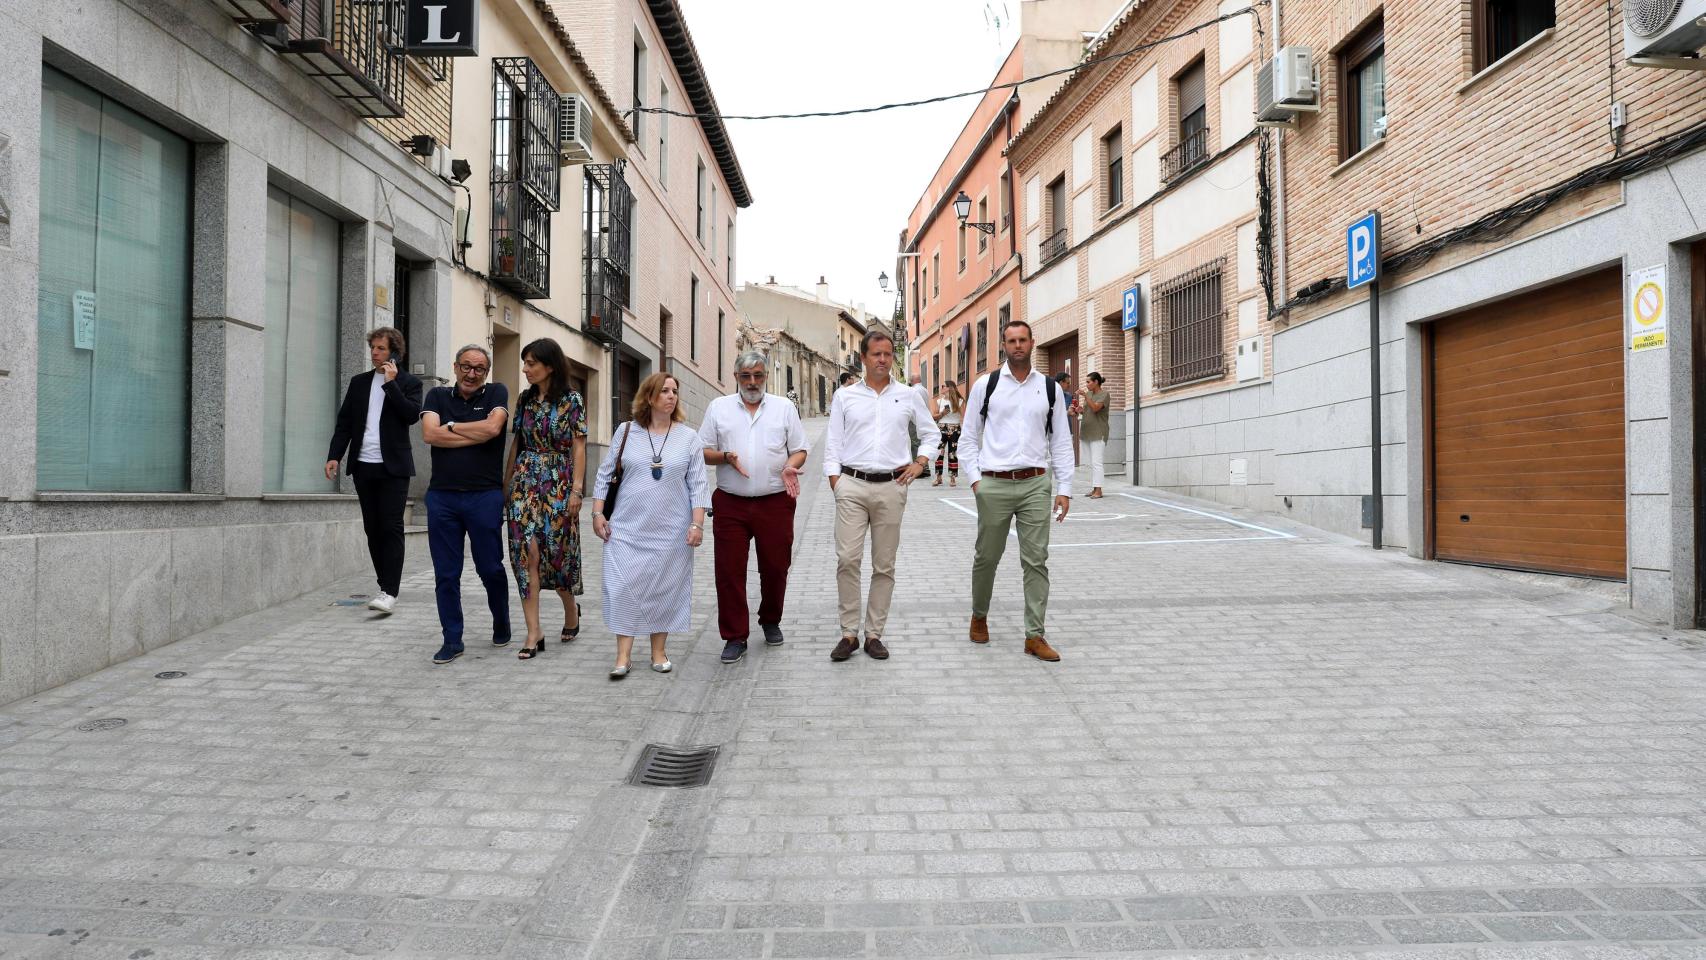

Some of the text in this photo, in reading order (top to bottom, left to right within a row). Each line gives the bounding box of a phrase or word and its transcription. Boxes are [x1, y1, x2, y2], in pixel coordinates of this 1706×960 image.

[421, 5, 461, 43] L
[1352, 226, 1370, 281] P
[1125, 292, 1135, 326] P
[1634, 340, 1663, 349] PERMANENTE
